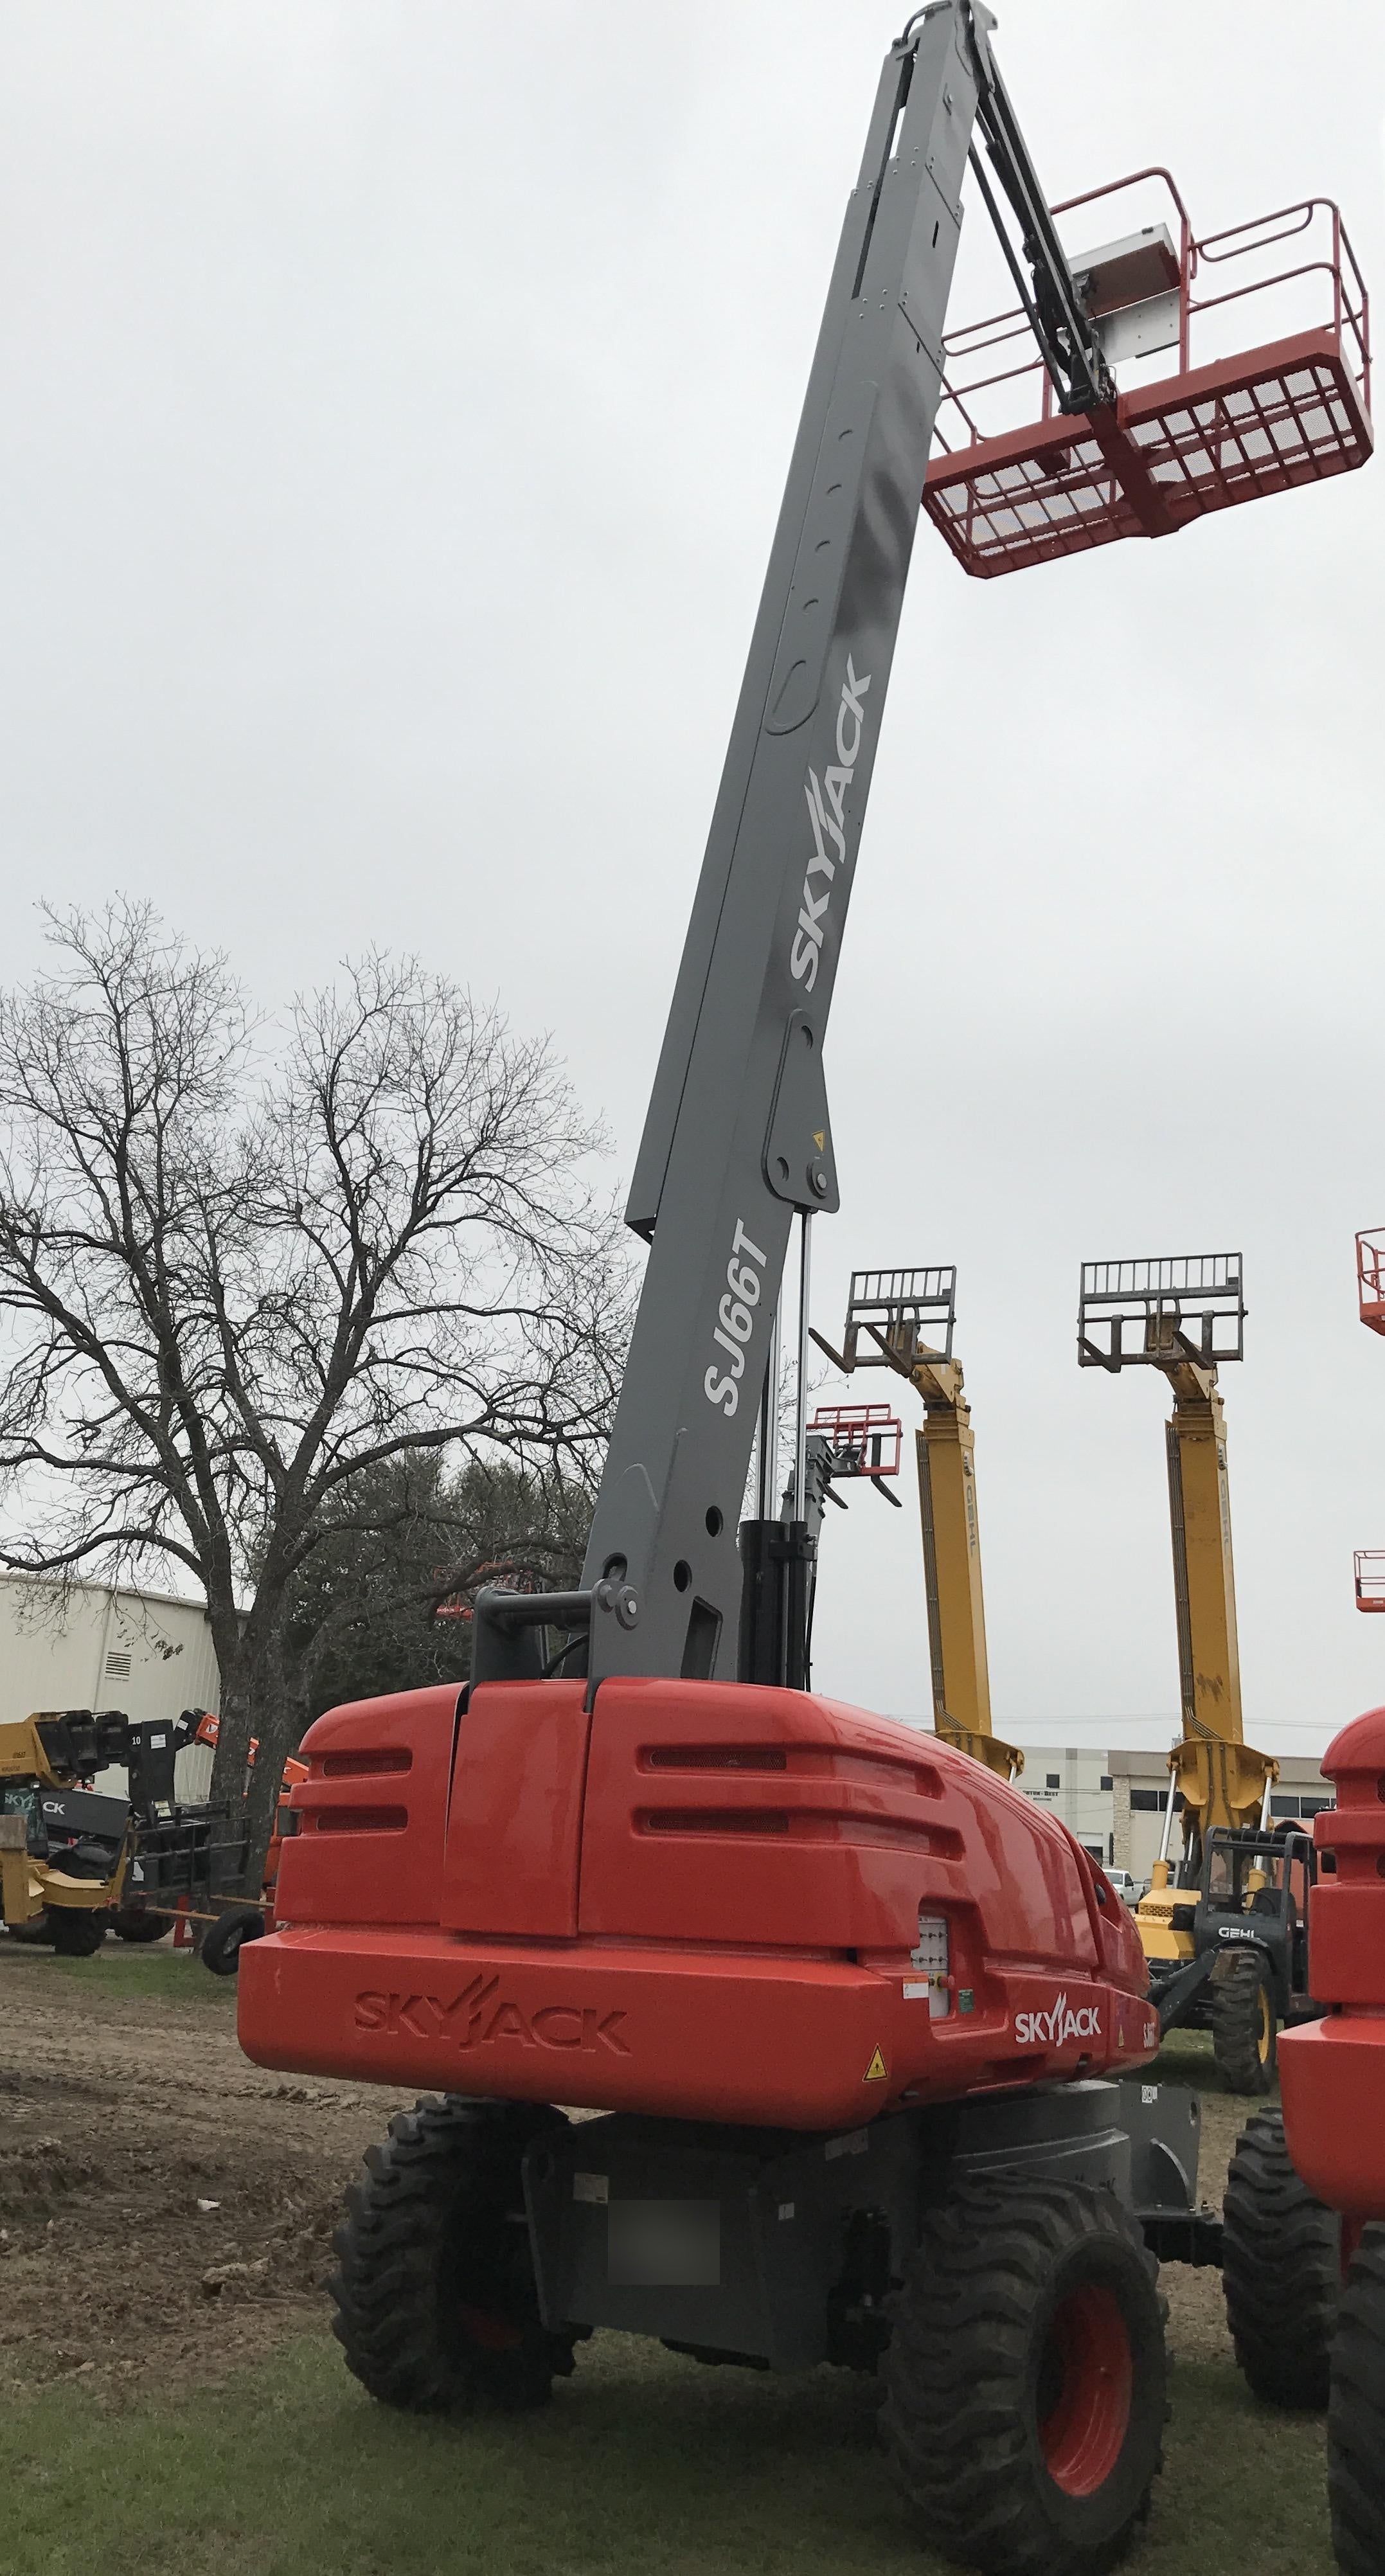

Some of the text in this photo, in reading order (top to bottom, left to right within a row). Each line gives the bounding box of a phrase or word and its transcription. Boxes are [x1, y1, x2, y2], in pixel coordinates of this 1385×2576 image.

[791, 653, 871, 992] SKYJACK
[704, 1218, 767, 1417] SJ66T
[354, 1973, 632, 2057] SKYJACK
[1015, 1992, 1102, 2047] SKYJACK
